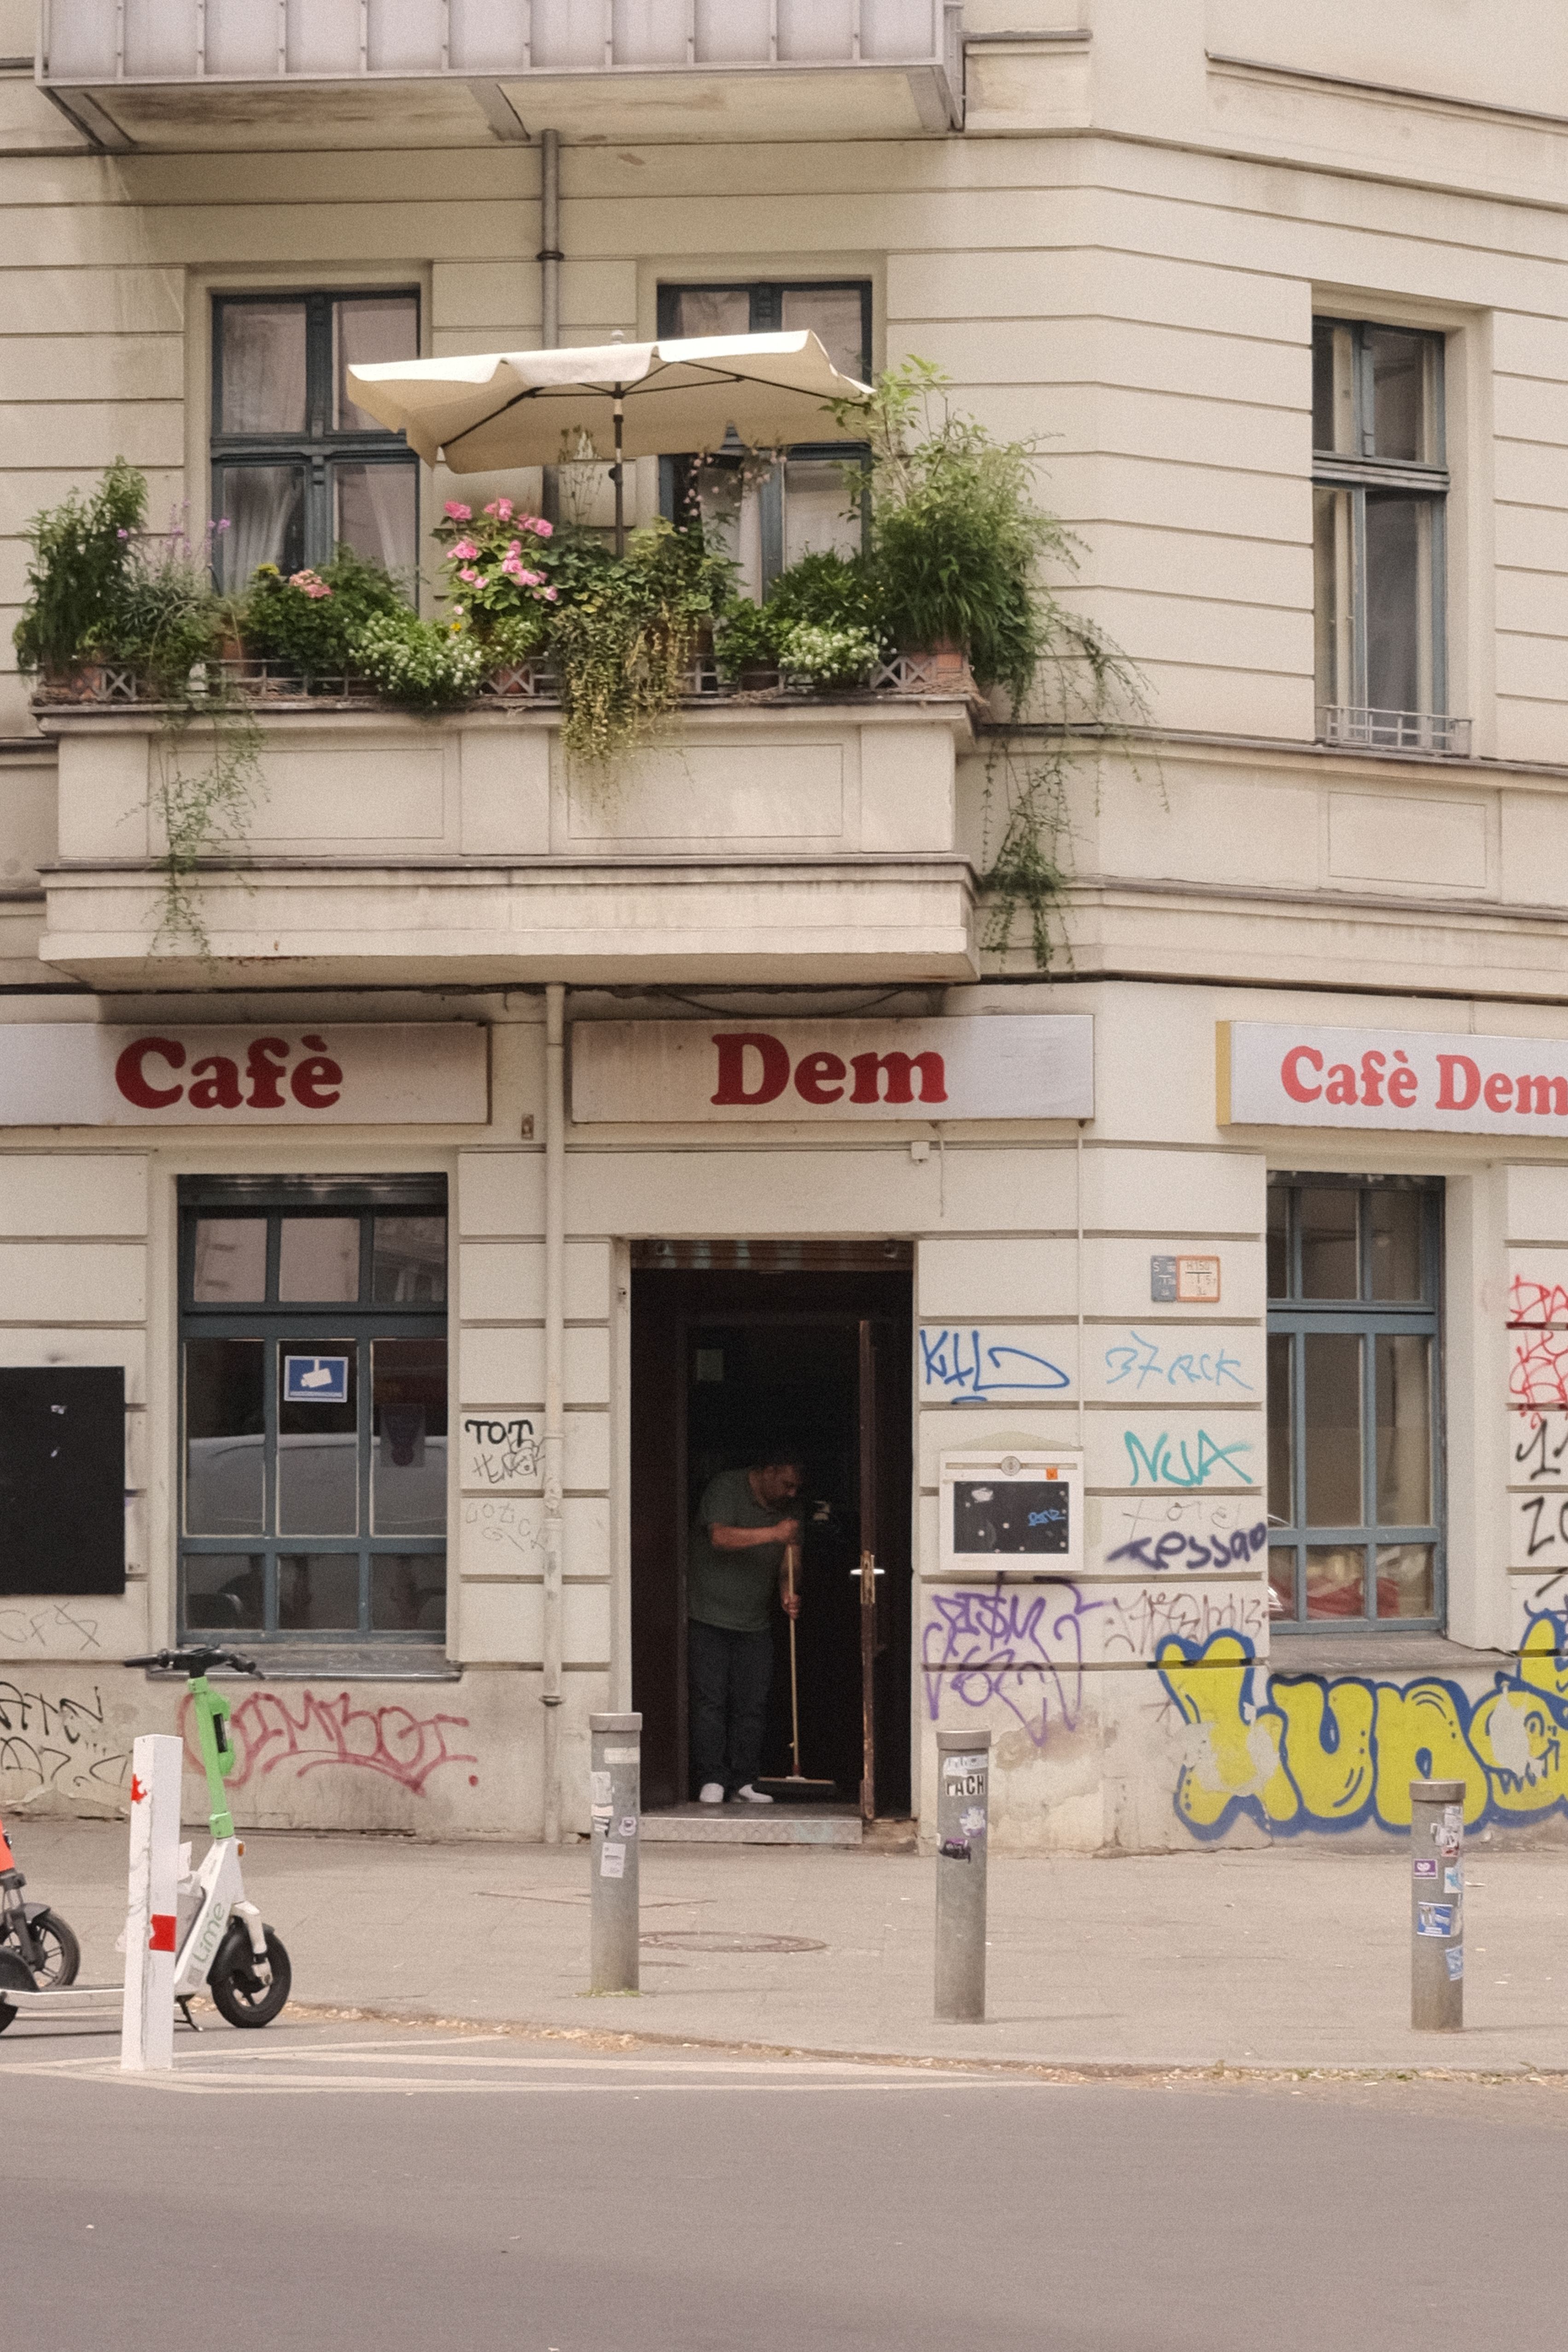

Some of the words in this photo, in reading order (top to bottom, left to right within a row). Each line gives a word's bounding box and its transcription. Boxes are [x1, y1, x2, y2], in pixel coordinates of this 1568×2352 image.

[115, 1035, 343, 1109] Cafè
[710, 1032, 949, 1106] Dem
[1281, 1045, 1418, 1108] Cafè
[1435, 1054, 1568, 1115] Dem
[465, 1419, 534, 1448] TOT
[192, 1902, 225, 1963] Lime
